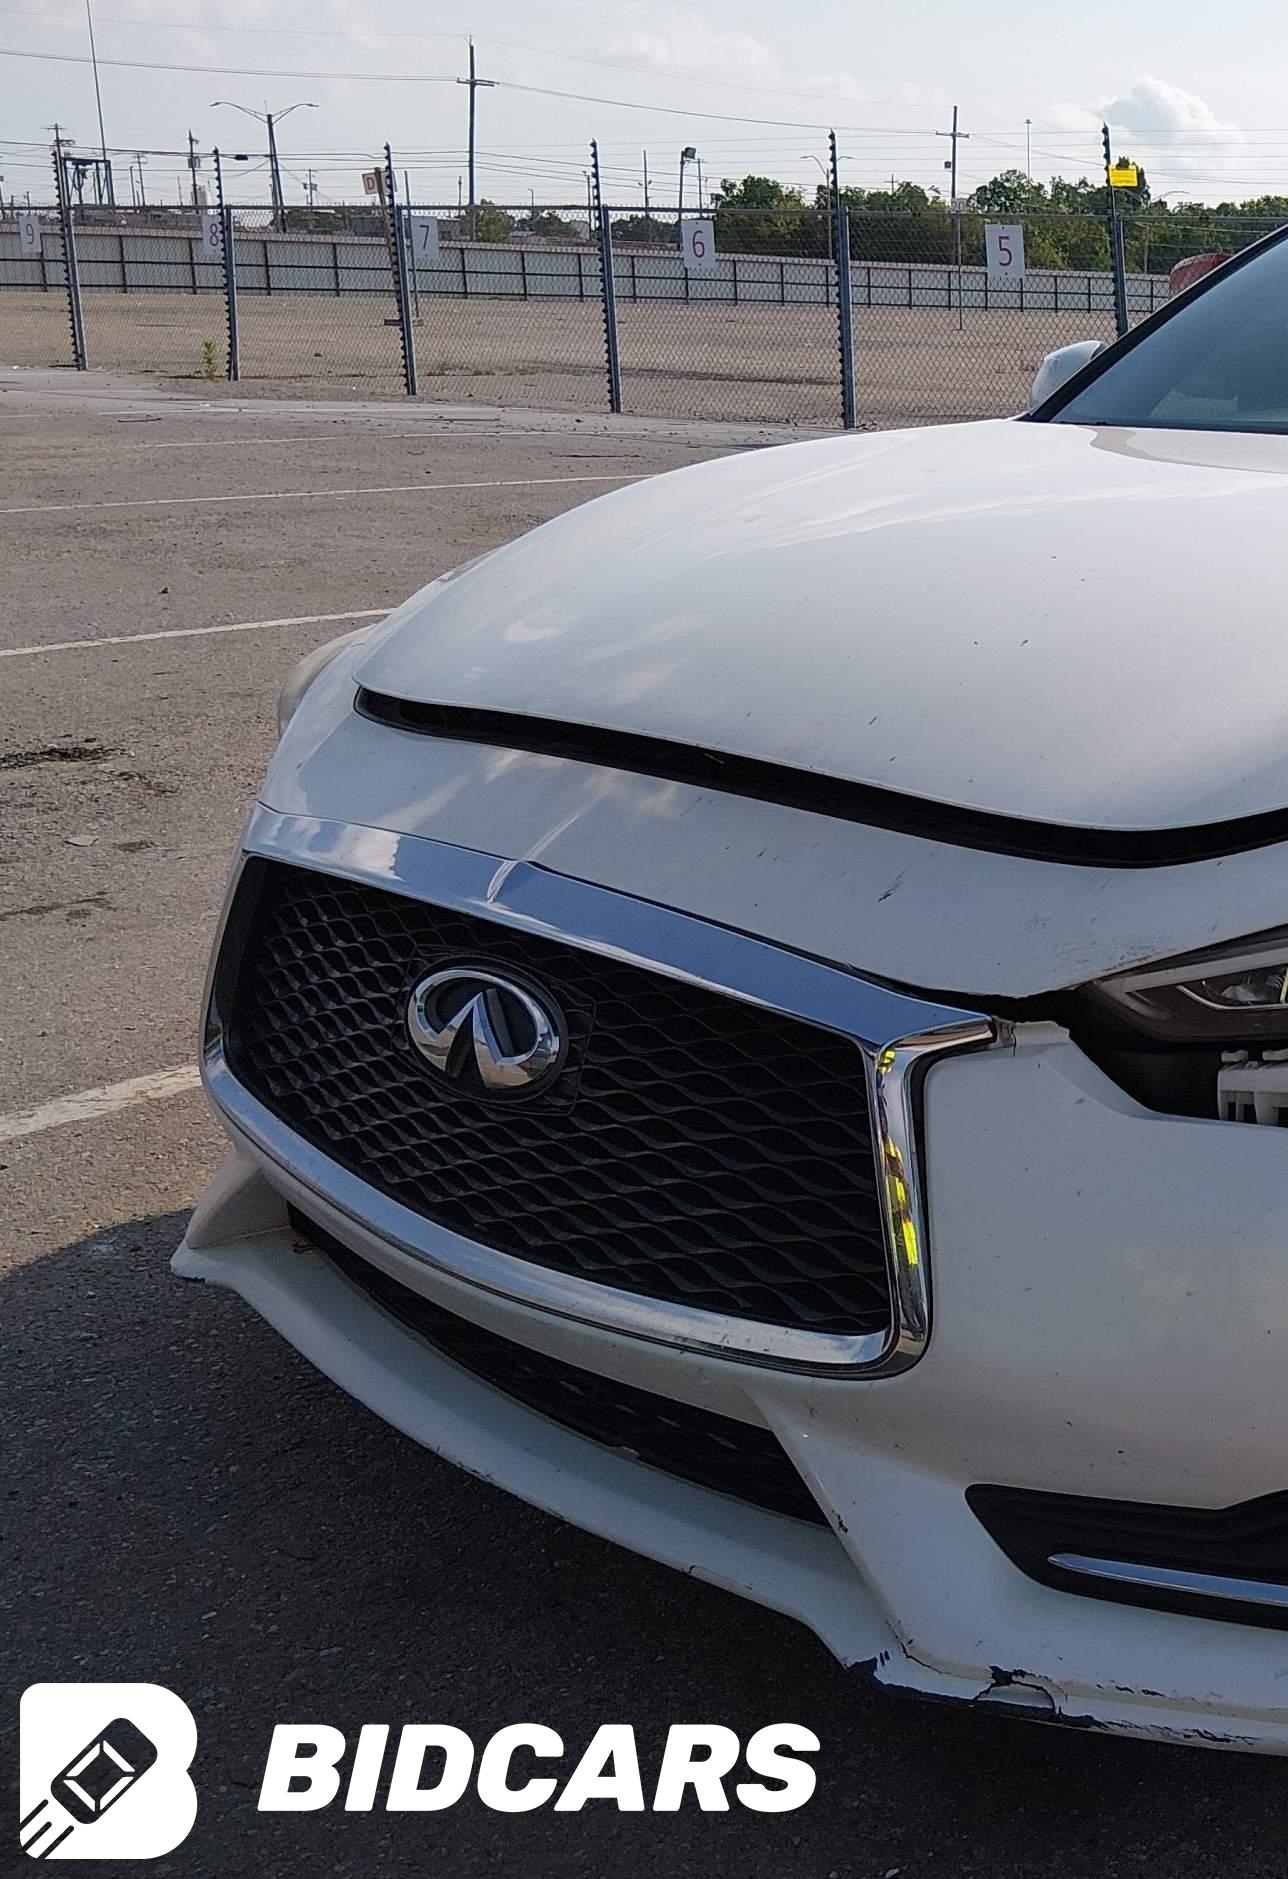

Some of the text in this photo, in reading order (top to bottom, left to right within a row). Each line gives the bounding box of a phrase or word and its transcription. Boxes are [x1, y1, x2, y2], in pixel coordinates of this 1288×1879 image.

[366, 177, 375, 191] D
[25, 223, 35, 245] 9
[210, 223, 219, 247] 8
[418, 224, 430, 250] 7
[692, 230, 706, 258] 6
[998, 235, 1013, 267] 5
